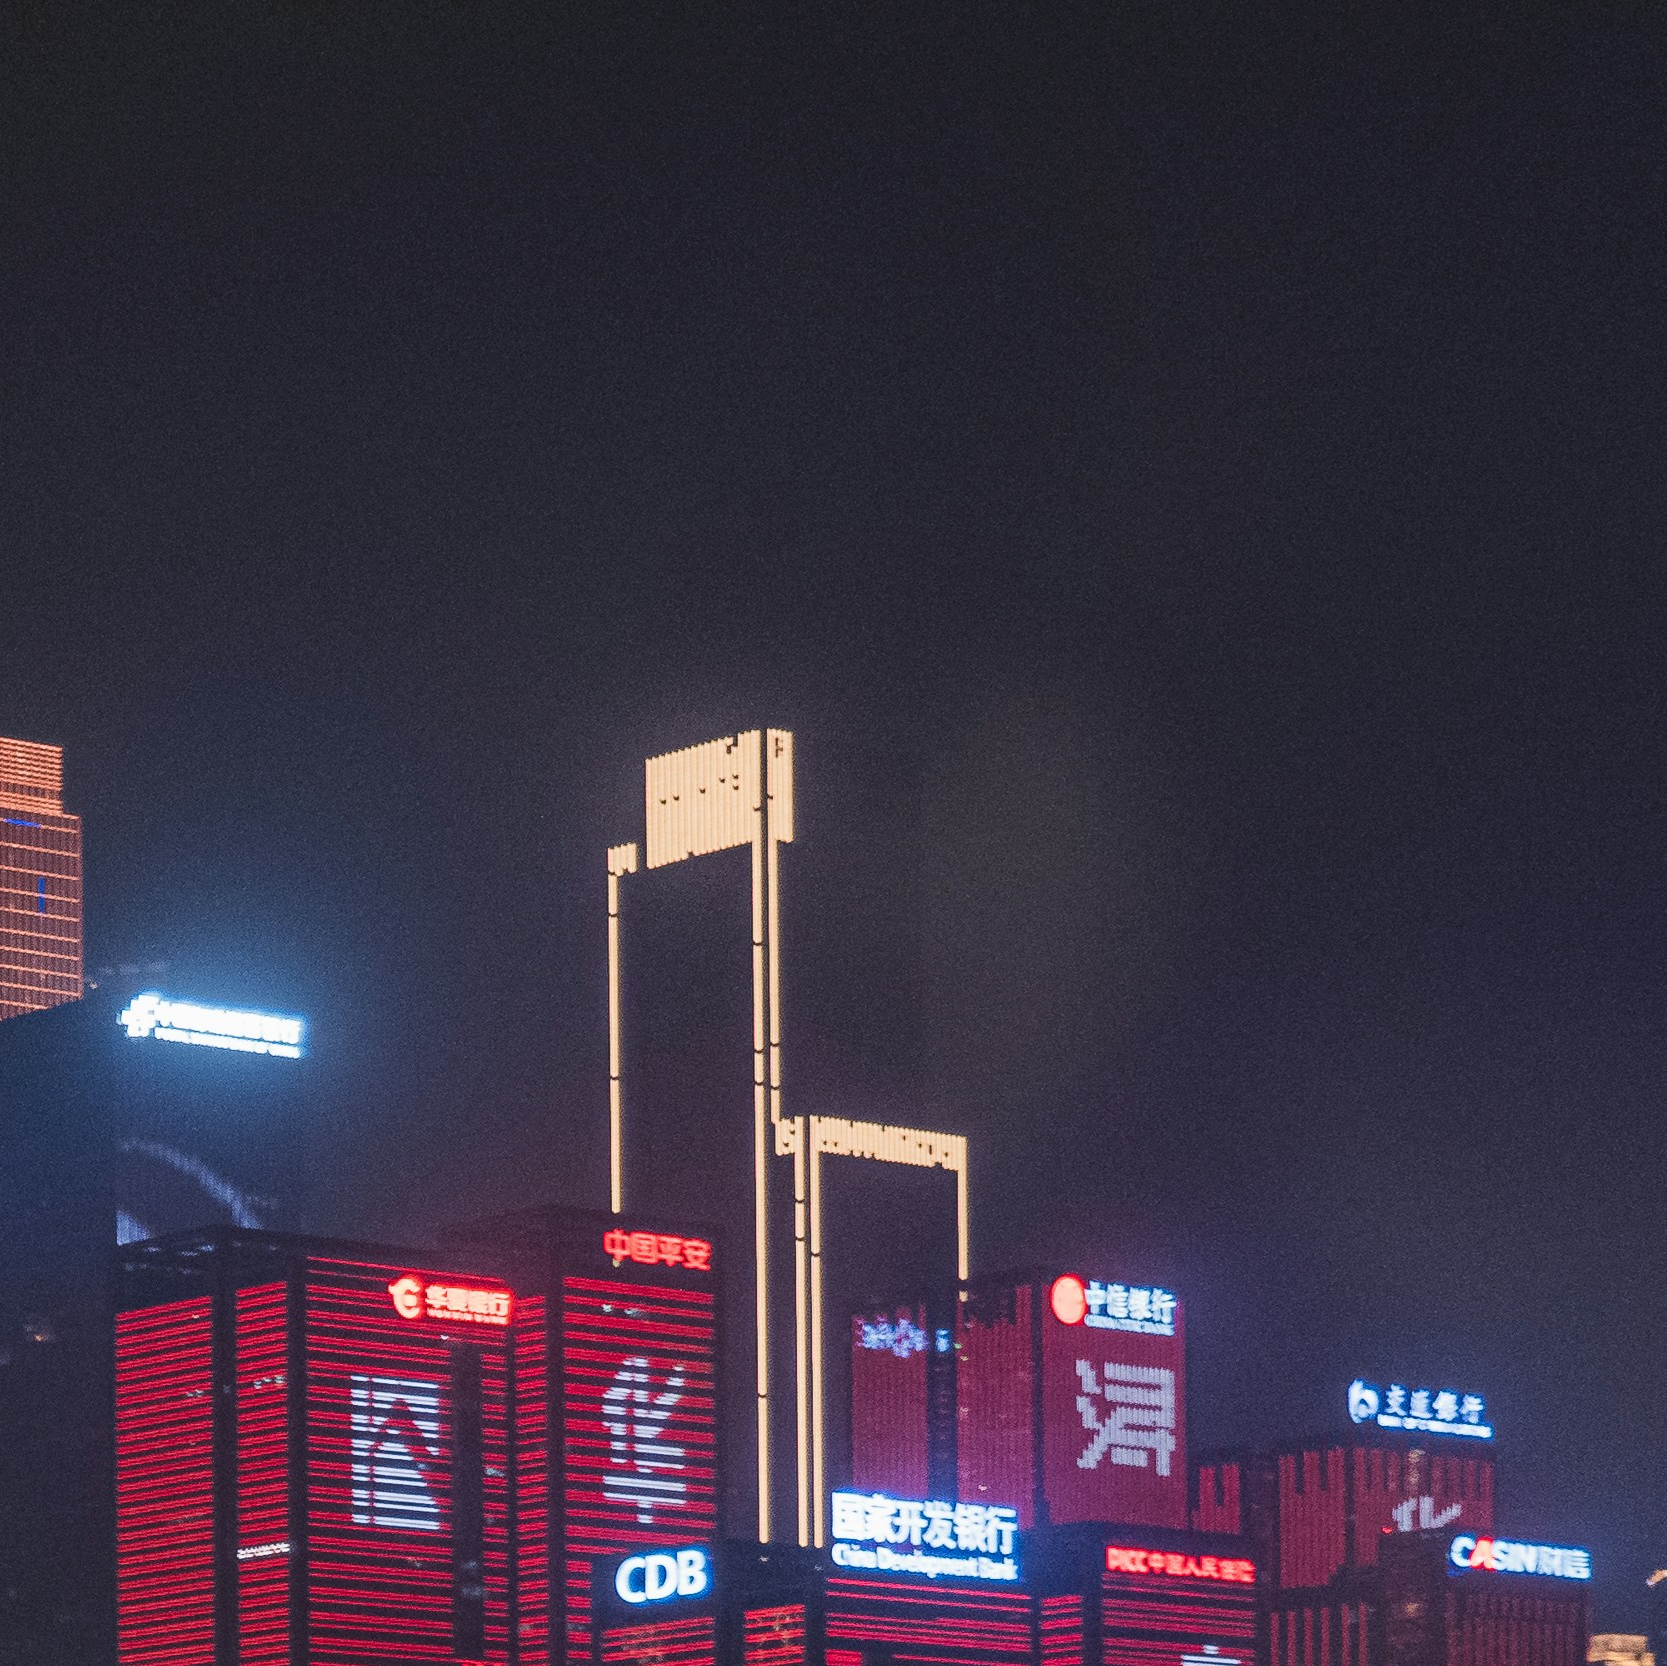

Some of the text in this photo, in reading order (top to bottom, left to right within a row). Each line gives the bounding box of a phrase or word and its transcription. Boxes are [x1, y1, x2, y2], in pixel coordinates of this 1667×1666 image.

[603, 1227, 712, 1271] 中国平安
[1084, 1279, 1178, 1325] 中信银行
[1385, 1382, 1485, 1424] 交通银行
[831, 1491, 1019, 1555] 国家开发银行
[614, 1549, 708, 1604] CDB
[831, 1542, 1019, 1581] China Development Bank
